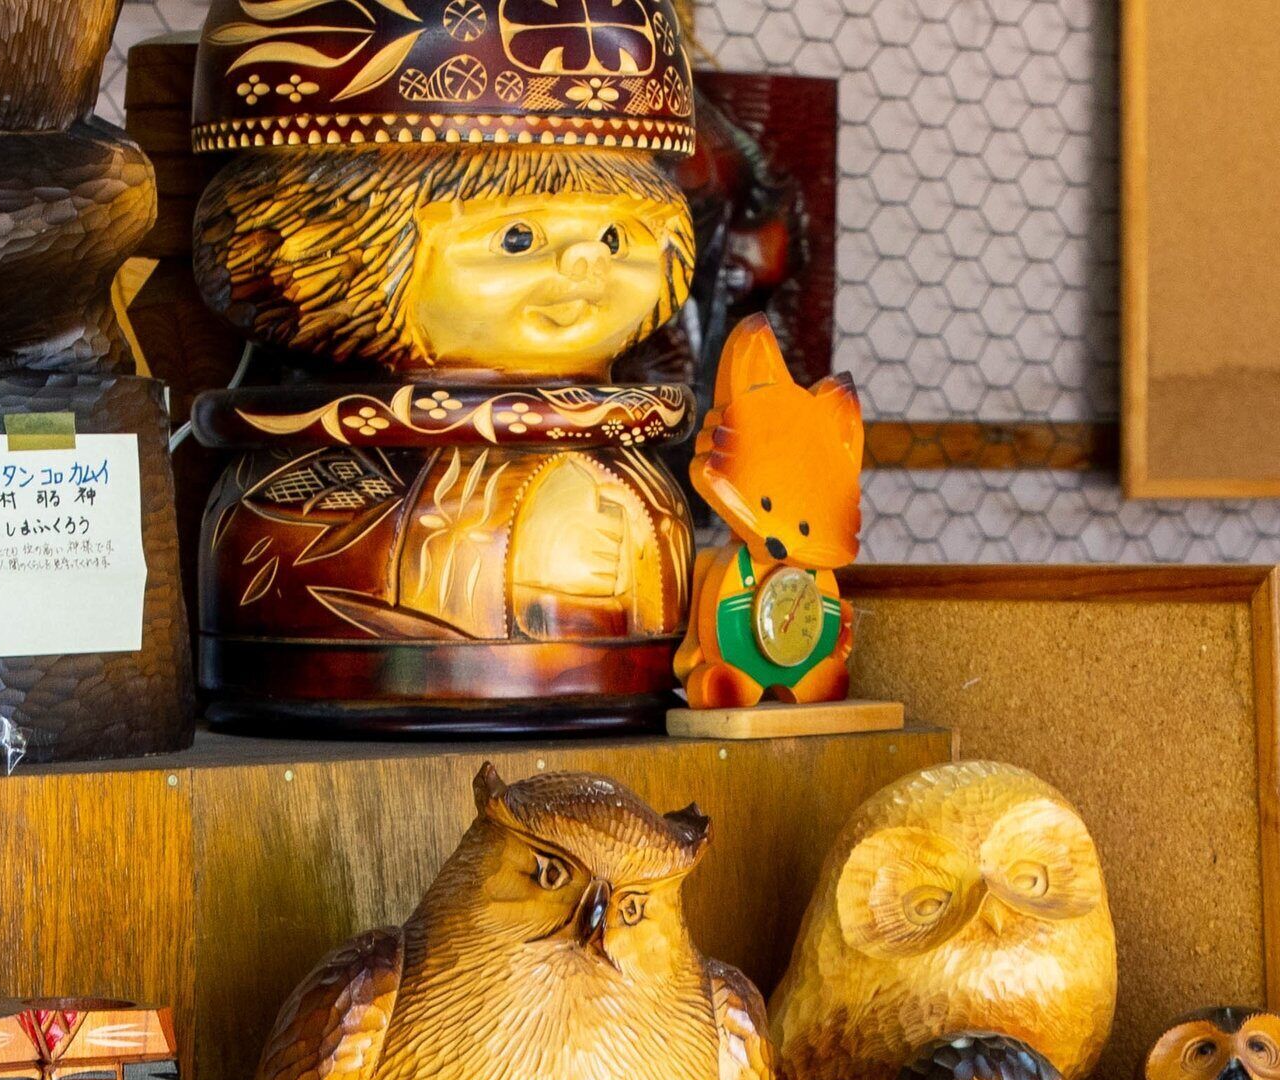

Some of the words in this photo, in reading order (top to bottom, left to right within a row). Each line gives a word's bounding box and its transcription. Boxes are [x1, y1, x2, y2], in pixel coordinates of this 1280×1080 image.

[6, 516, 90, 536] しまふくろう
